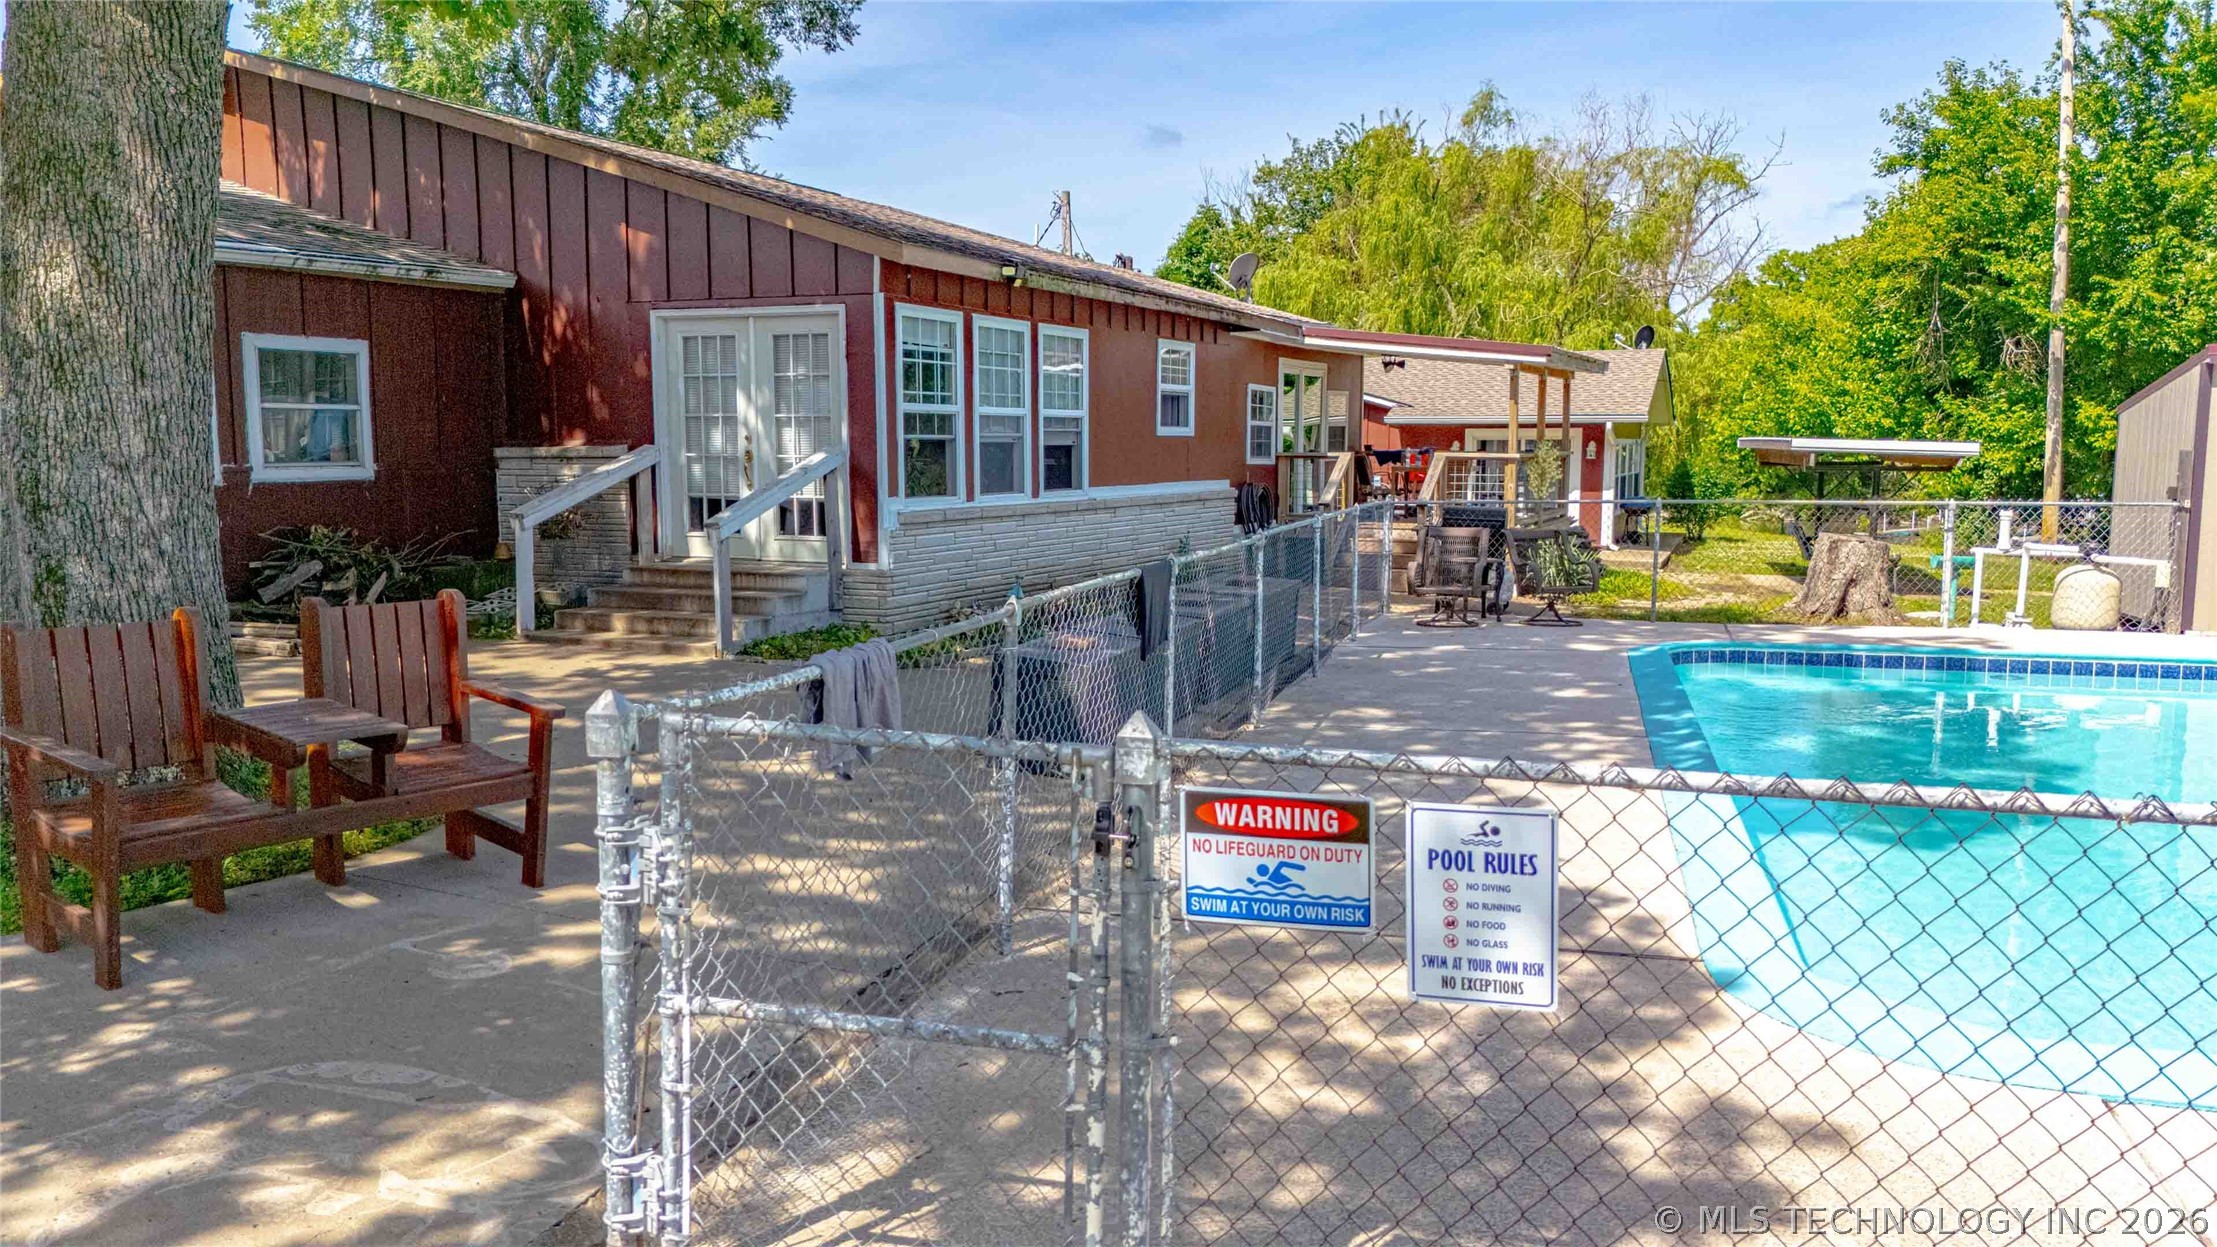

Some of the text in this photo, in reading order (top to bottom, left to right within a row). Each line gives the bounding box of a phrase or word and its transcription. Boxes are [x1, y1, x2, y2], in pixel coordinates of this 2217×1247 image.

[1214, 802, 1339, 833] WARNING
[1192, 838, 1363, 864] NO LIFEGUARD ON DUTY
[1428, 848, 1538, 876] POOL RULES
[1466, 883, 1511, 893] NO DIVING
[1191, 897, 1365, 922] SWIM AT YOUR OWN RISK
[1466, 902, 1521, 913] NO RUNNING
[1466, 920, 1506, 931] NO FOOD
[1466, 939, 1508, 949] NO GLASS
[1421, 954, 1544, 977] SWIM AT YOUR OWN RISK
[1441, 975, 1524, 995] NO EXCEPTIONS
